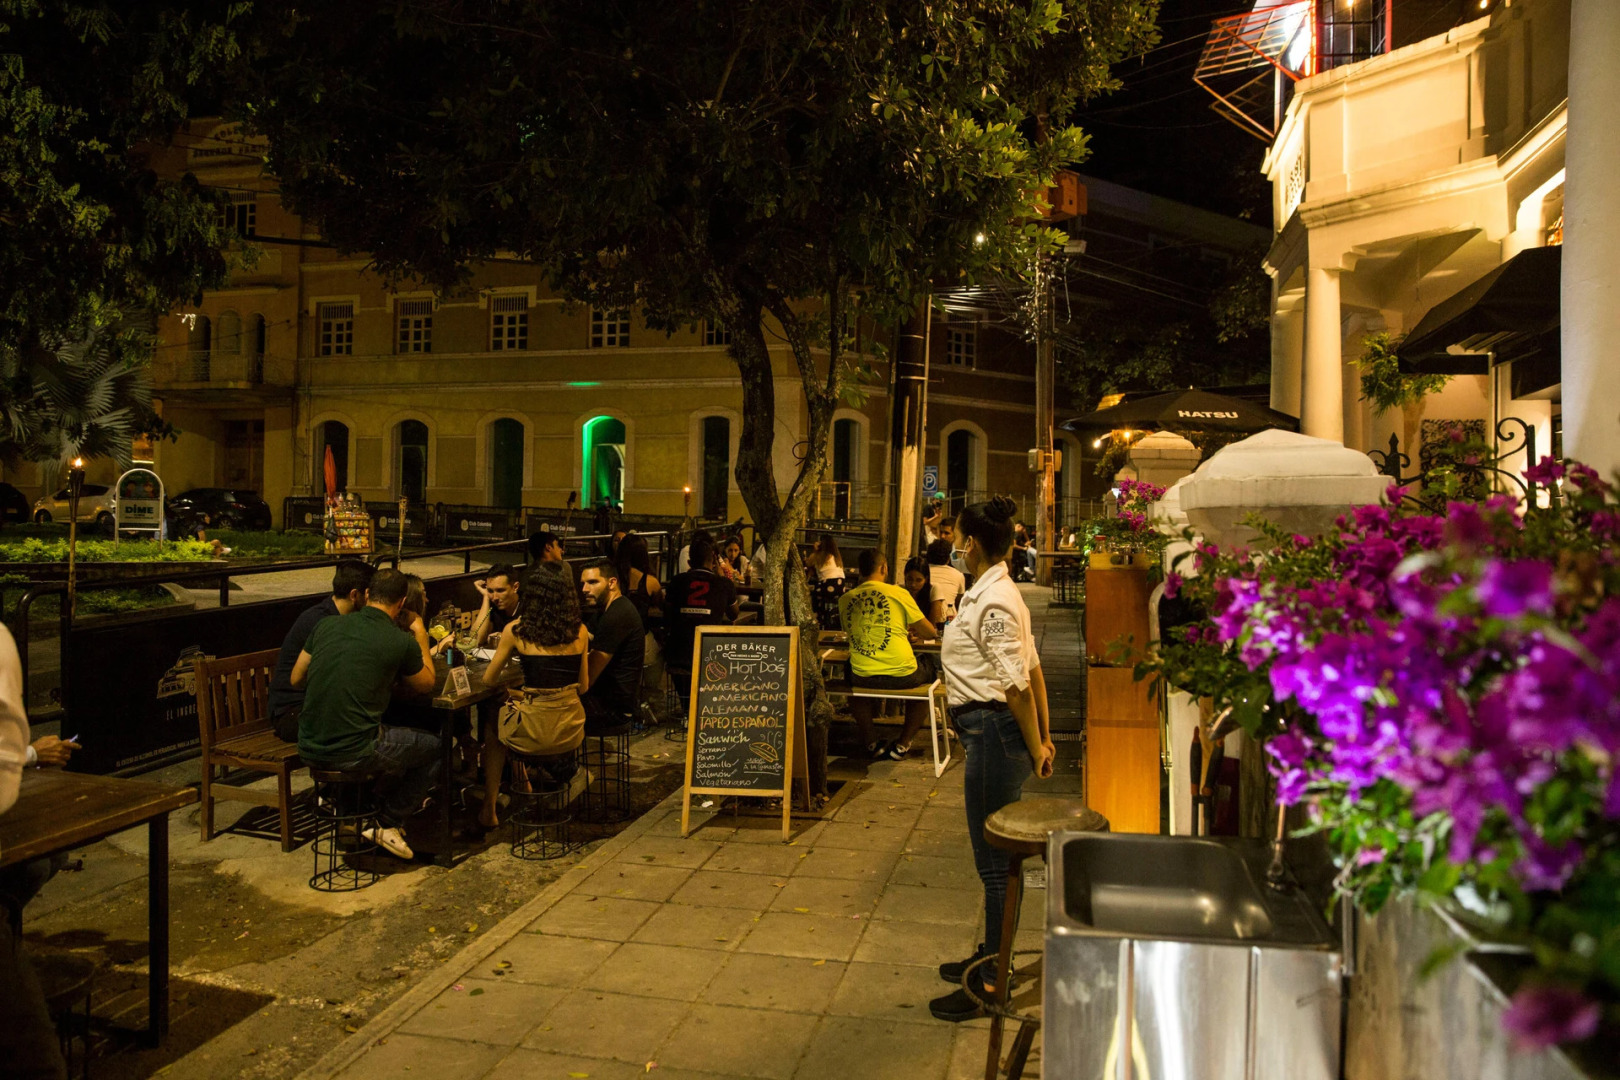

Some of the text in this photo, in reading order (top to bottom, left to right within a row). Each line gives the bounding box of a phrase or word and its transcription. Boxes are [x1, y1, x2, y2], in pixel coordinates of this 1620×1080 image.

[1178, 410, 1239, 419] HATSU
[687, 580, 711, 606] 2
[871, 590, 890, 615] STRIVE
[878, 627, 892, 651] WAVE
[715, 643, 737, 652] DER
[729, 661, 786, 677] HOT DOG
[703, 682, 780, 693] AMERICANO
[717, 692, 788, 702] MEXICANO
[701, 704, 759, 716] ALEMAN
[699, 715, 784, 730] TAPEO ESPAÑOL
[698, 732, 750, 745] Sanwich
[698, 746, 727, 754] Serrano
[700, 779, 751, 787] Vegetariano
